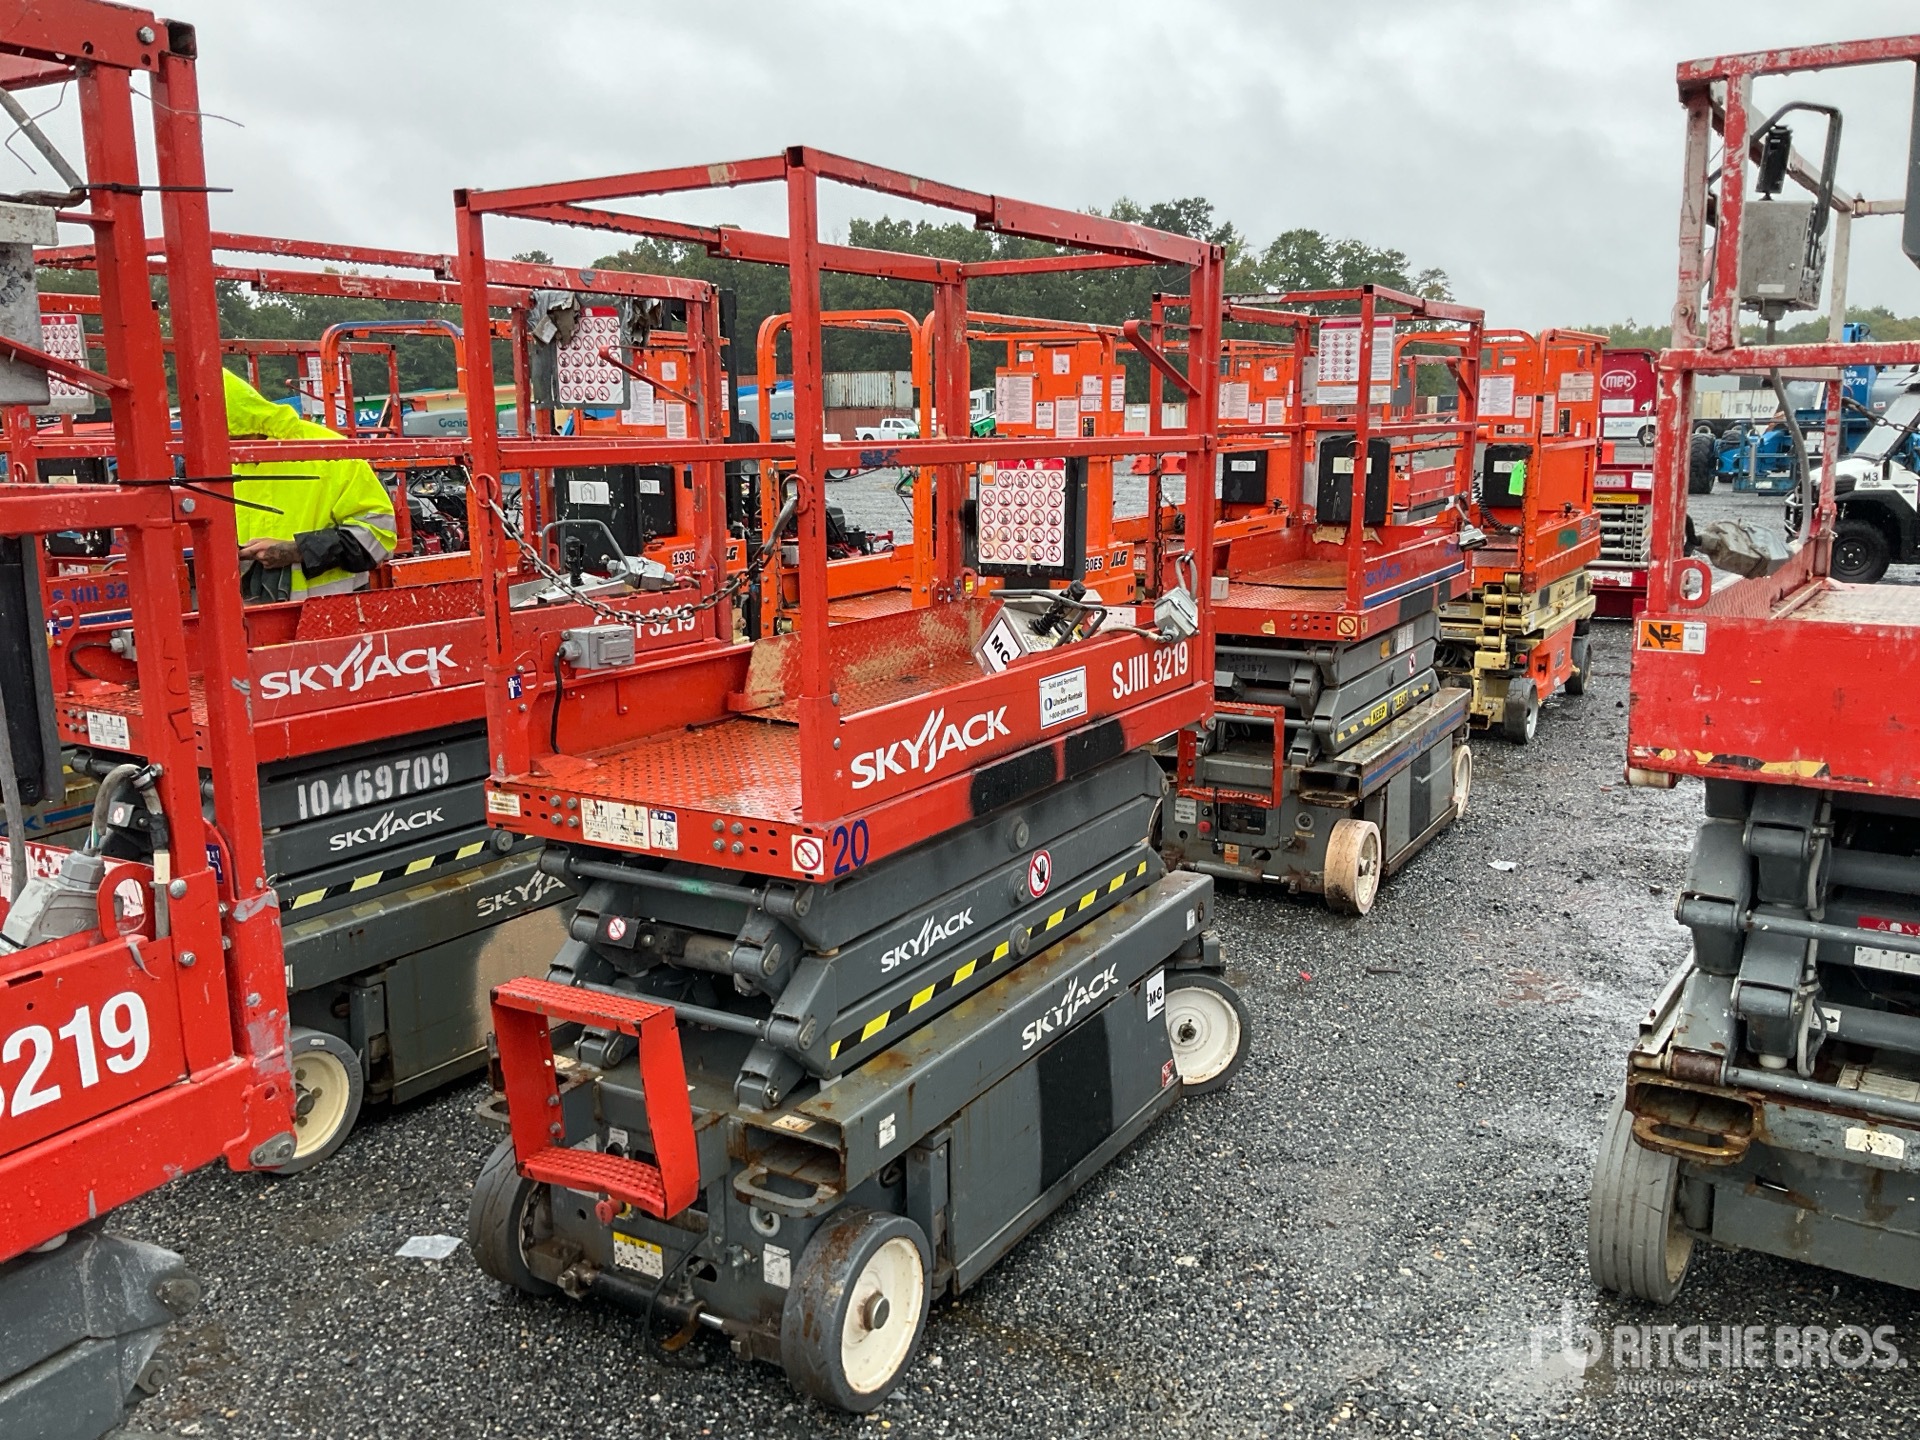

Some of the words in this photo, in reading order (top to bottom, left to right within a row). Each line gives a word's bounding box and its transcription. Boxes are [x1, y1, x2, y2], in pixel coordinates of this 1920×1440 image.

[770, 410, 794, 420] enie
[1110, 550, 1128, 567] JLG
[260, 635, 458, 700] SKYJACK
[1151, 639, 1190, 680] 3219
[850, 706, 1010, 790] SKYJACK
[329, 807, 444, 852] SKYJACK
[832, 818, 870, 876] 20
[880, 906, 974, 973] SKYJACK
[1021, 962, 1119, 1050] SKYJACK
[0, 992, 150, 1118] 219
